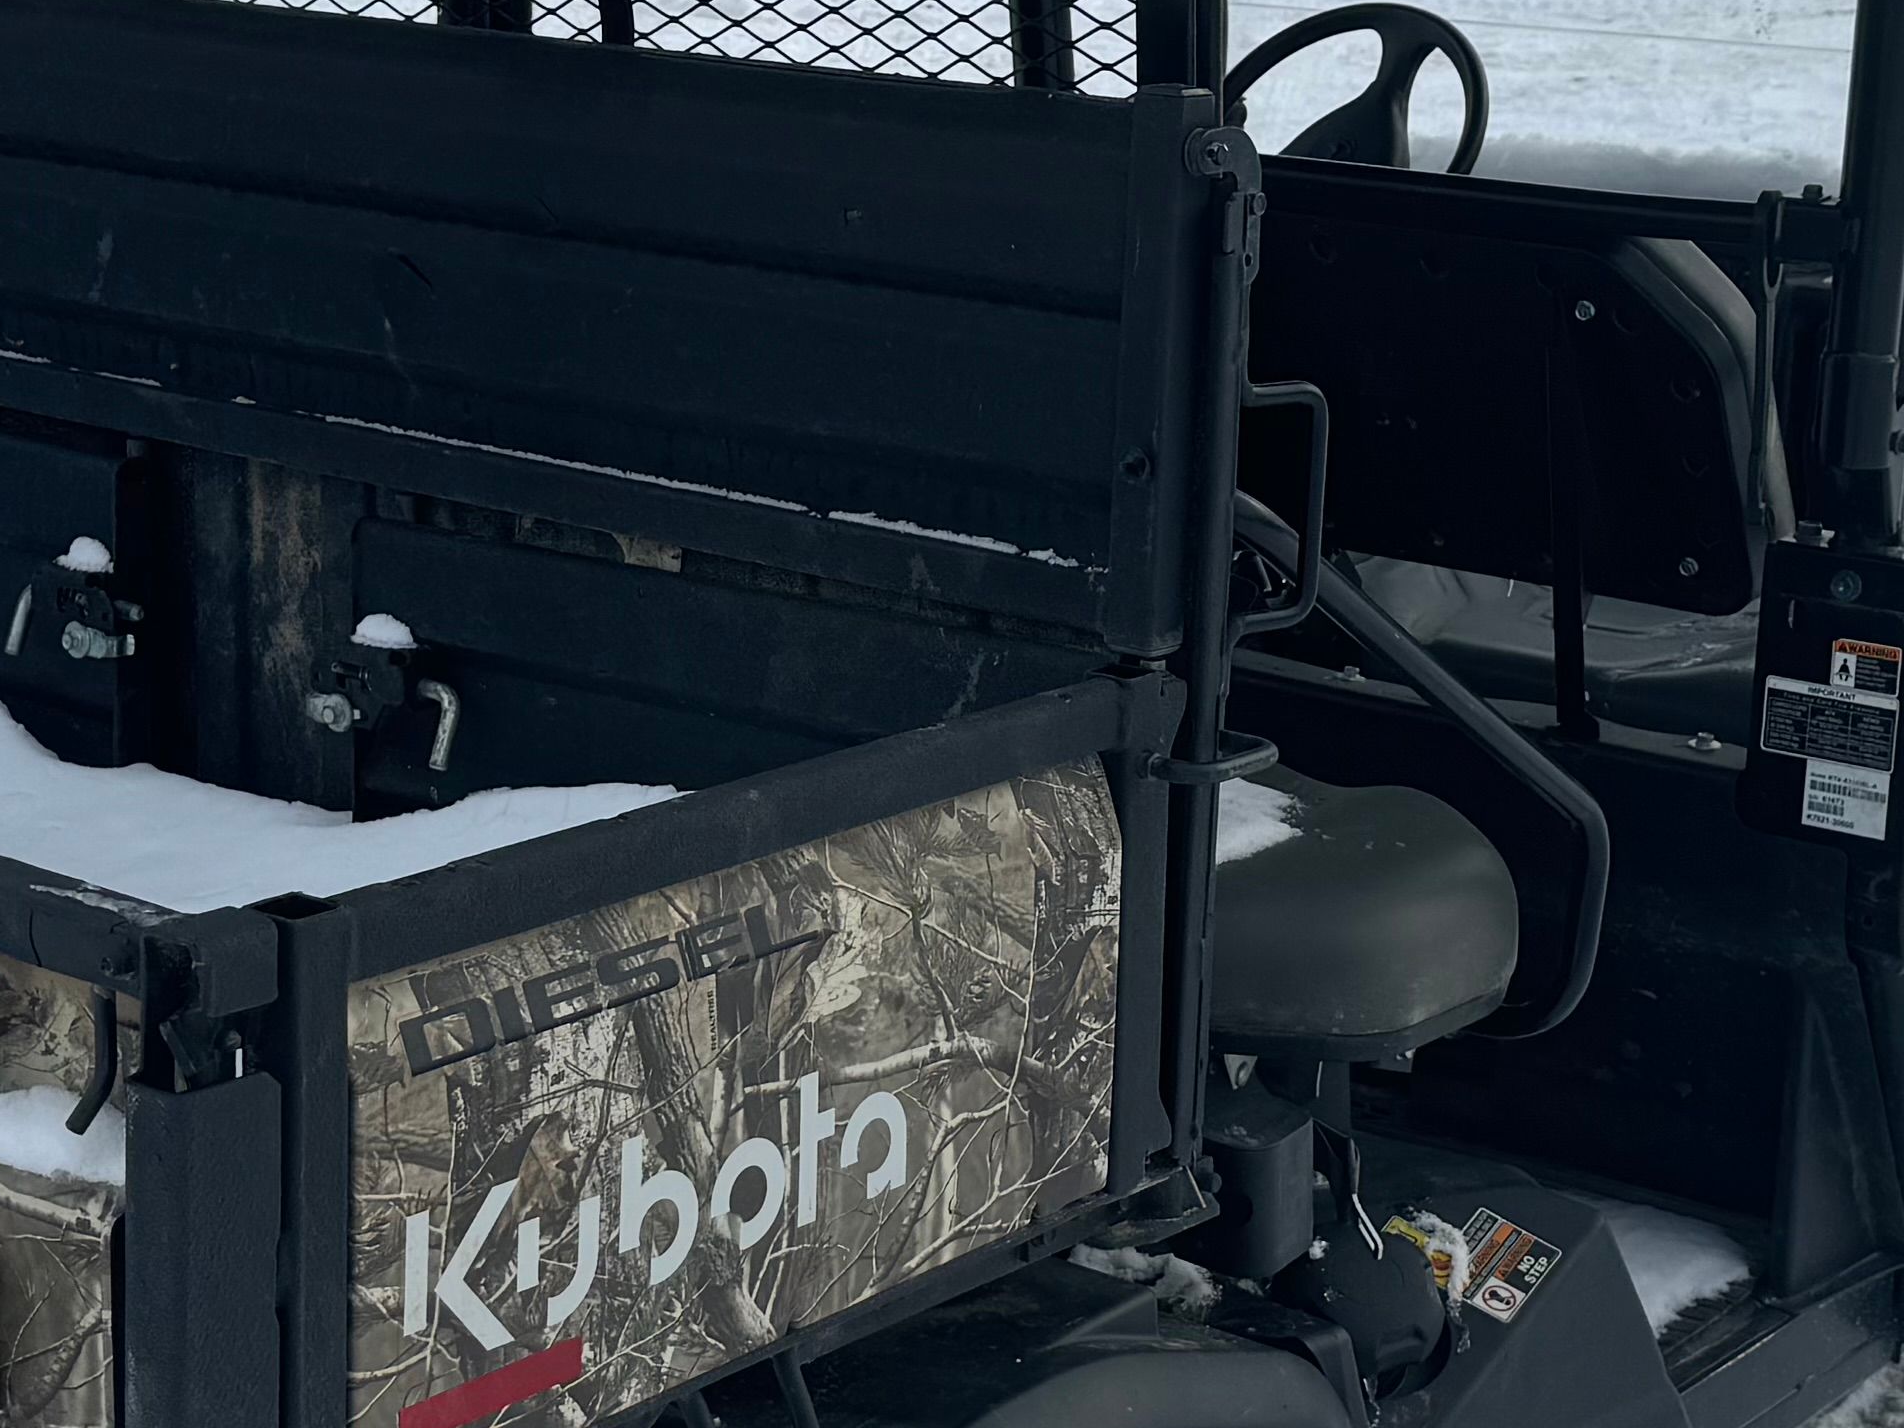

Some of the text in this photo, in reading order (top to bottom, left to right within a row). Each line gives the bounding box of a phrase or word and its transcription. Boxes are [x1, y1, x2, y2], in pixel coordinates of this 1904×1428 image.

[399, 905, 826, 1077] DIESEL
[402, 1071, 908, 1351] Kubota
[1517, 1255, 1536, 1273] NO
[1523, 1256, 1549, 1285] STEP
